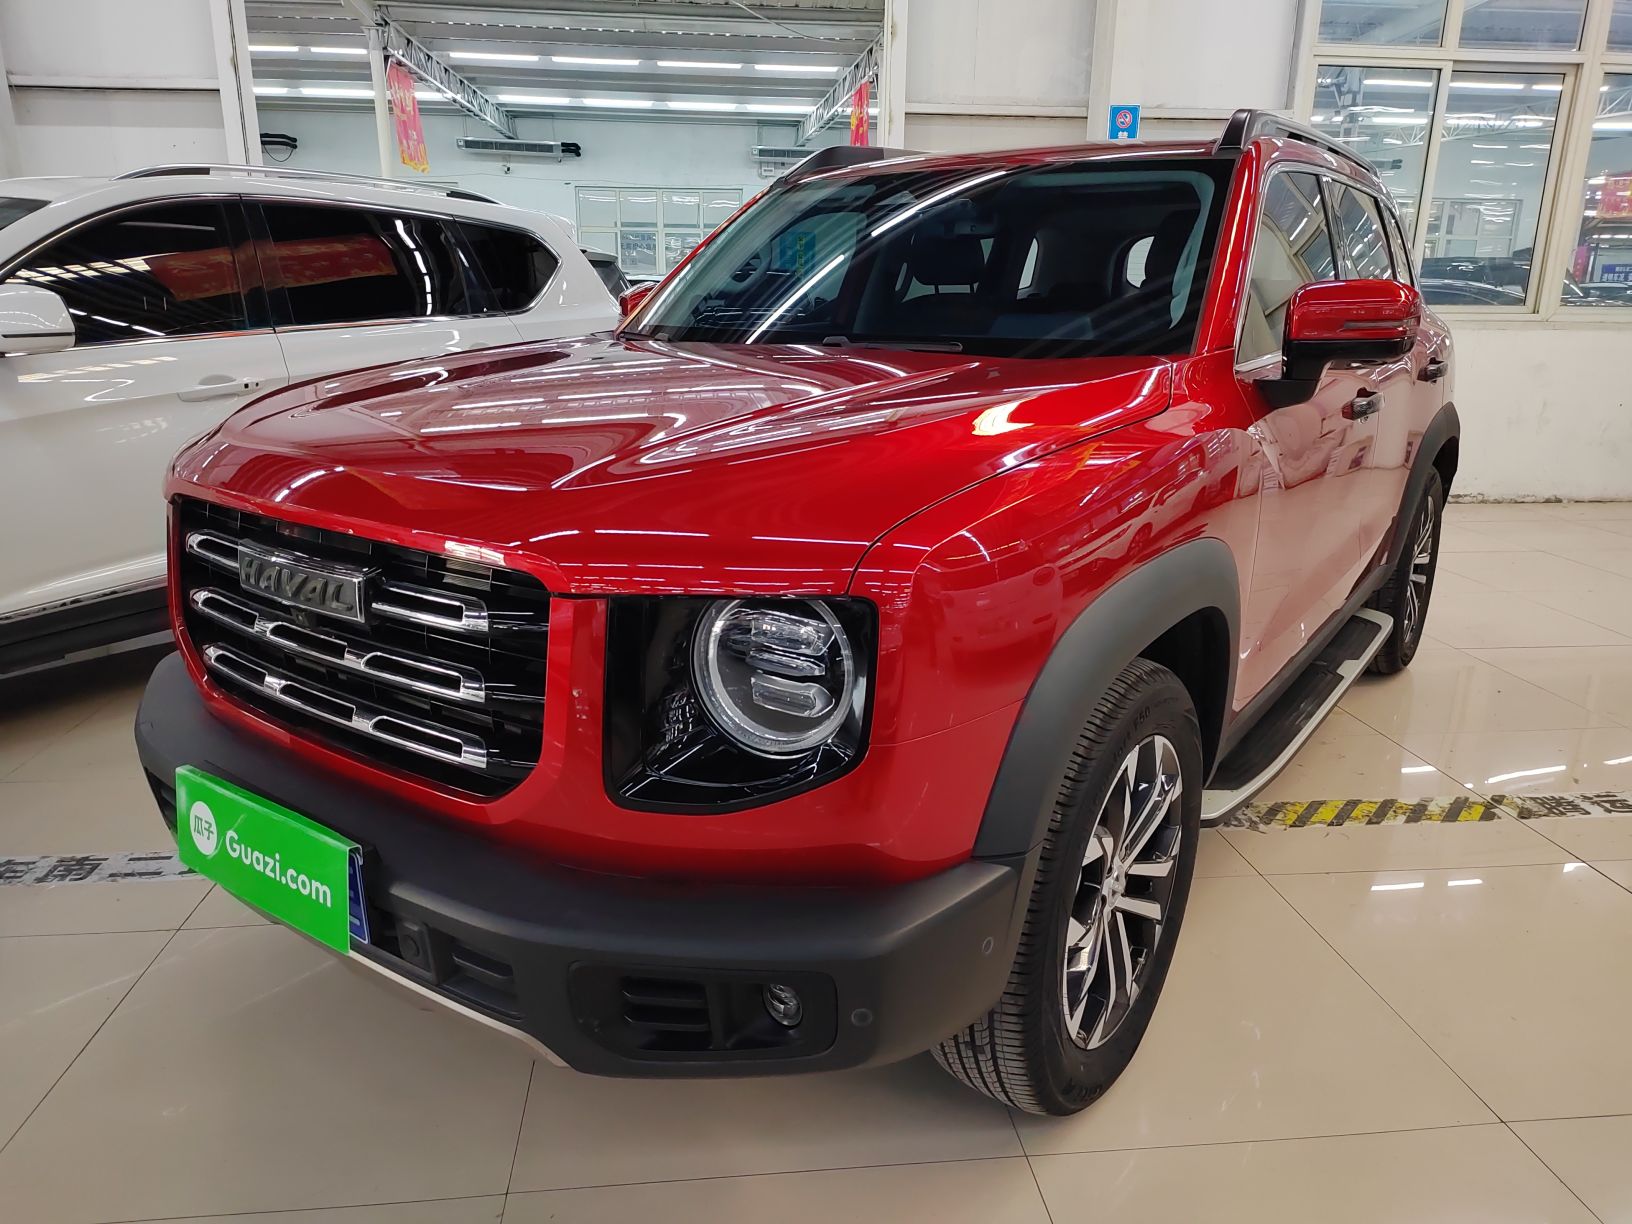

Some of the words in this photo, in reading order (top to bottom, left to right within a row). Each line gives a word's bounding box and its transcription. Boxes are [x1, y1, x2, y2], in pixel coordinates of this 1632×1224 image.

[240, 556, 354, 612] HAVAL
[193, 814, 215, 841] 瓜子
[225, 830, 332, 908] Guazi.com
